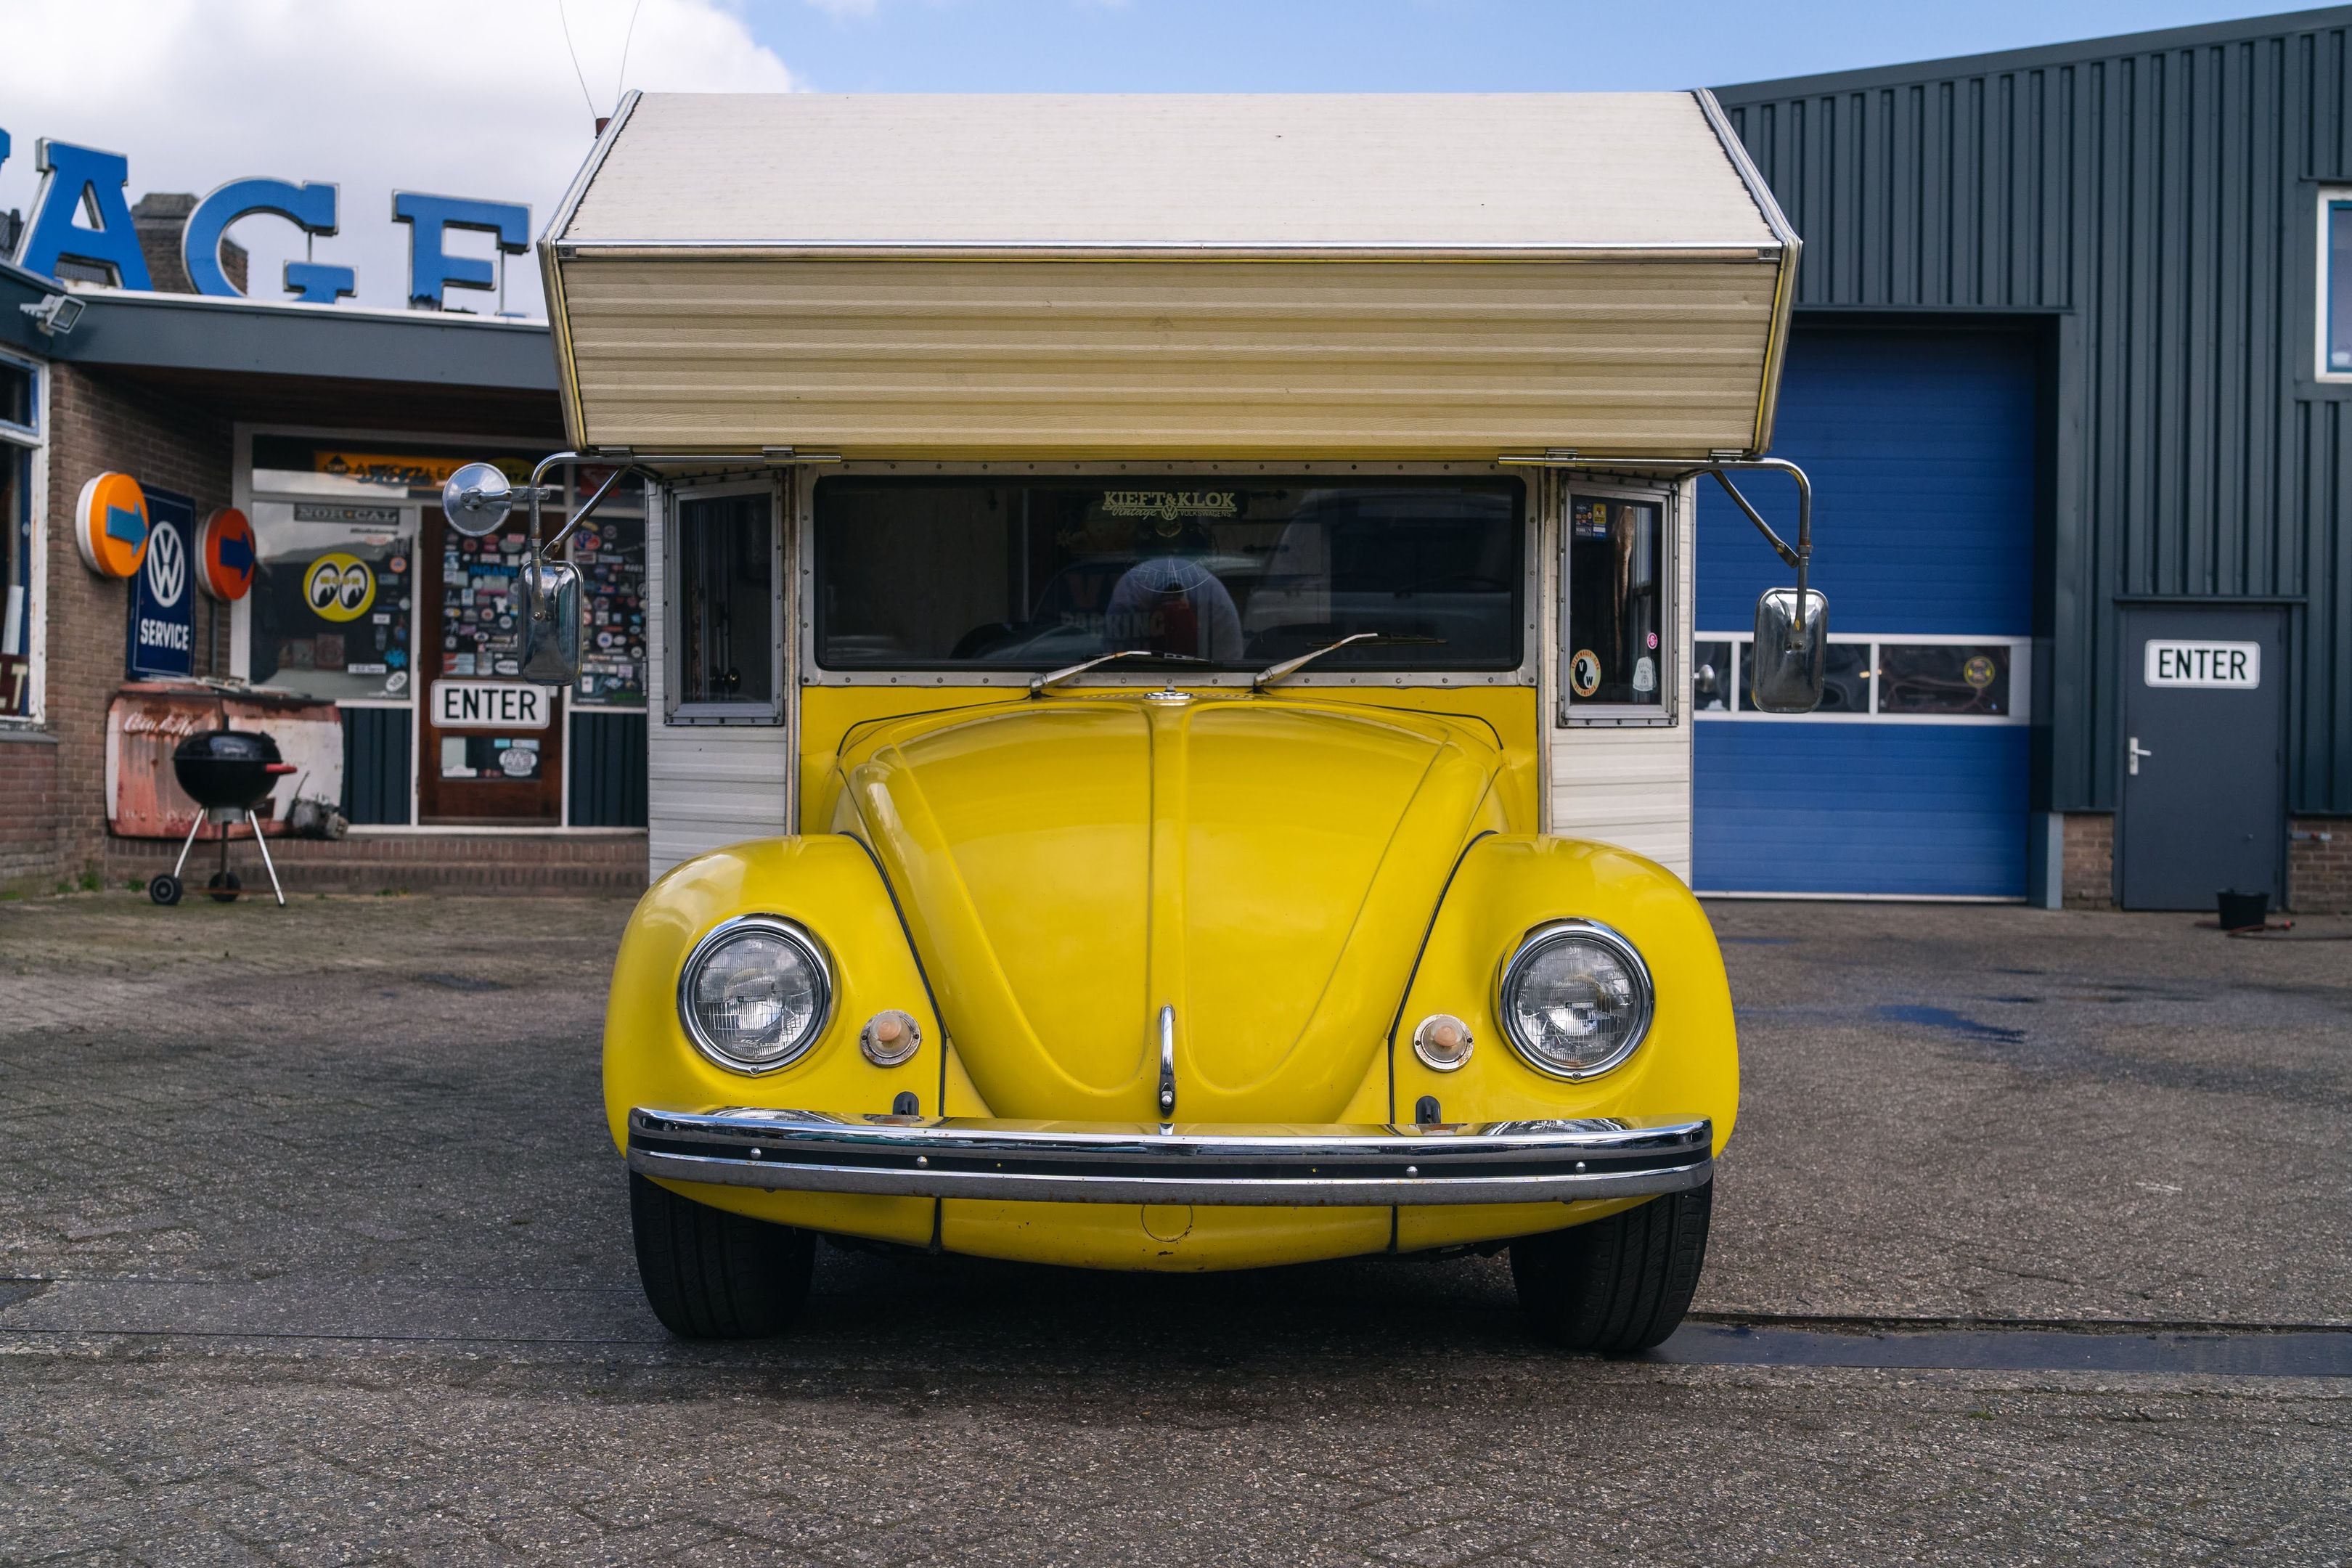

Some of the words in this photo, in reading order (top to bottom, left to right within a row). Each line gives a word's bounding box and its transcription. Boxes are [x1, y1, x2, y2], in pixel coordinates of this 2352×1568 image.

[0, 127, 531, 317] AGE
[1112, 506, 1157, 520] Vintage
[140, 618, 189, 651] SERVICE
[2158, 648, 2247, 680] ENTER
[444, 688, 536, 721] ENTER
